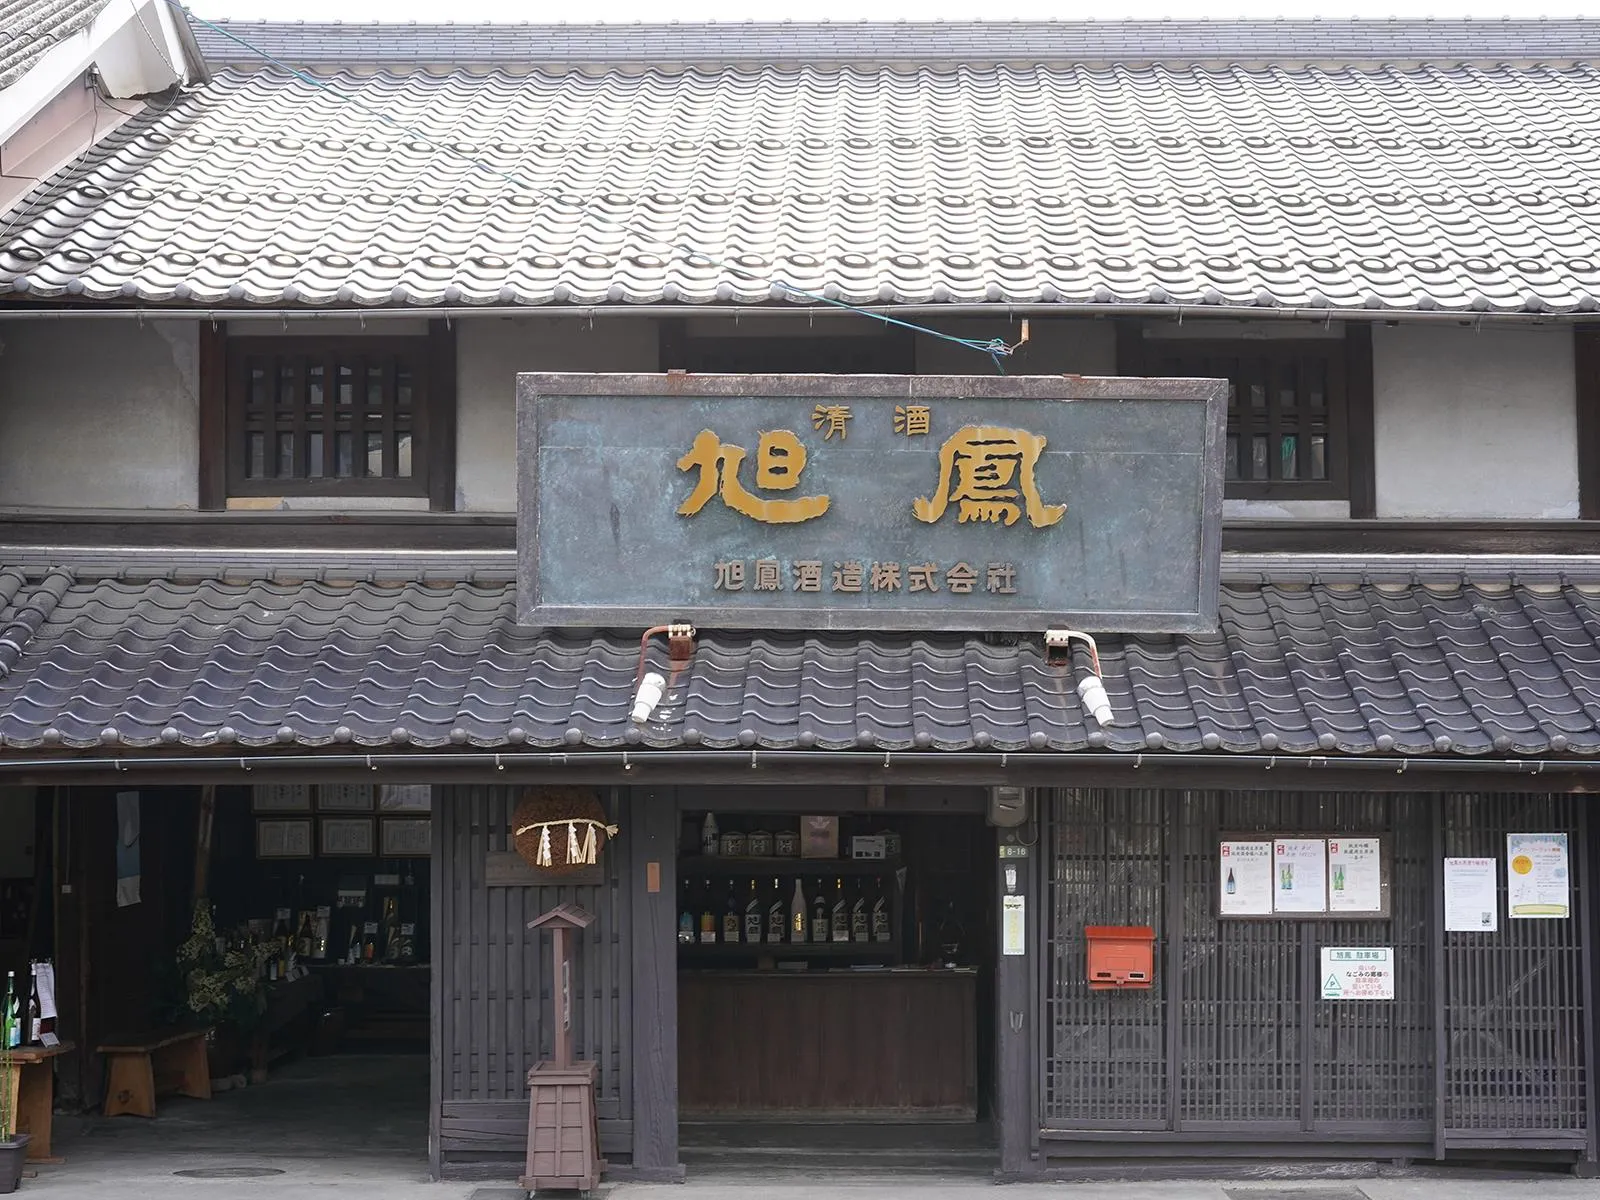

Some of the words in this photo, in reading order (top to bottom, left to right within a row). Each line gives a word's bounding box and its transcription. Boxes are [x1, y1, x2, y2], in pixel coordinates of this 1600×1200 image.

[811, 403, 931, 440] 清酒
[676, 424, 1067, 528] 旭鳳
[712, 558, 1017, 594] 旭鳳酒造株式会社
